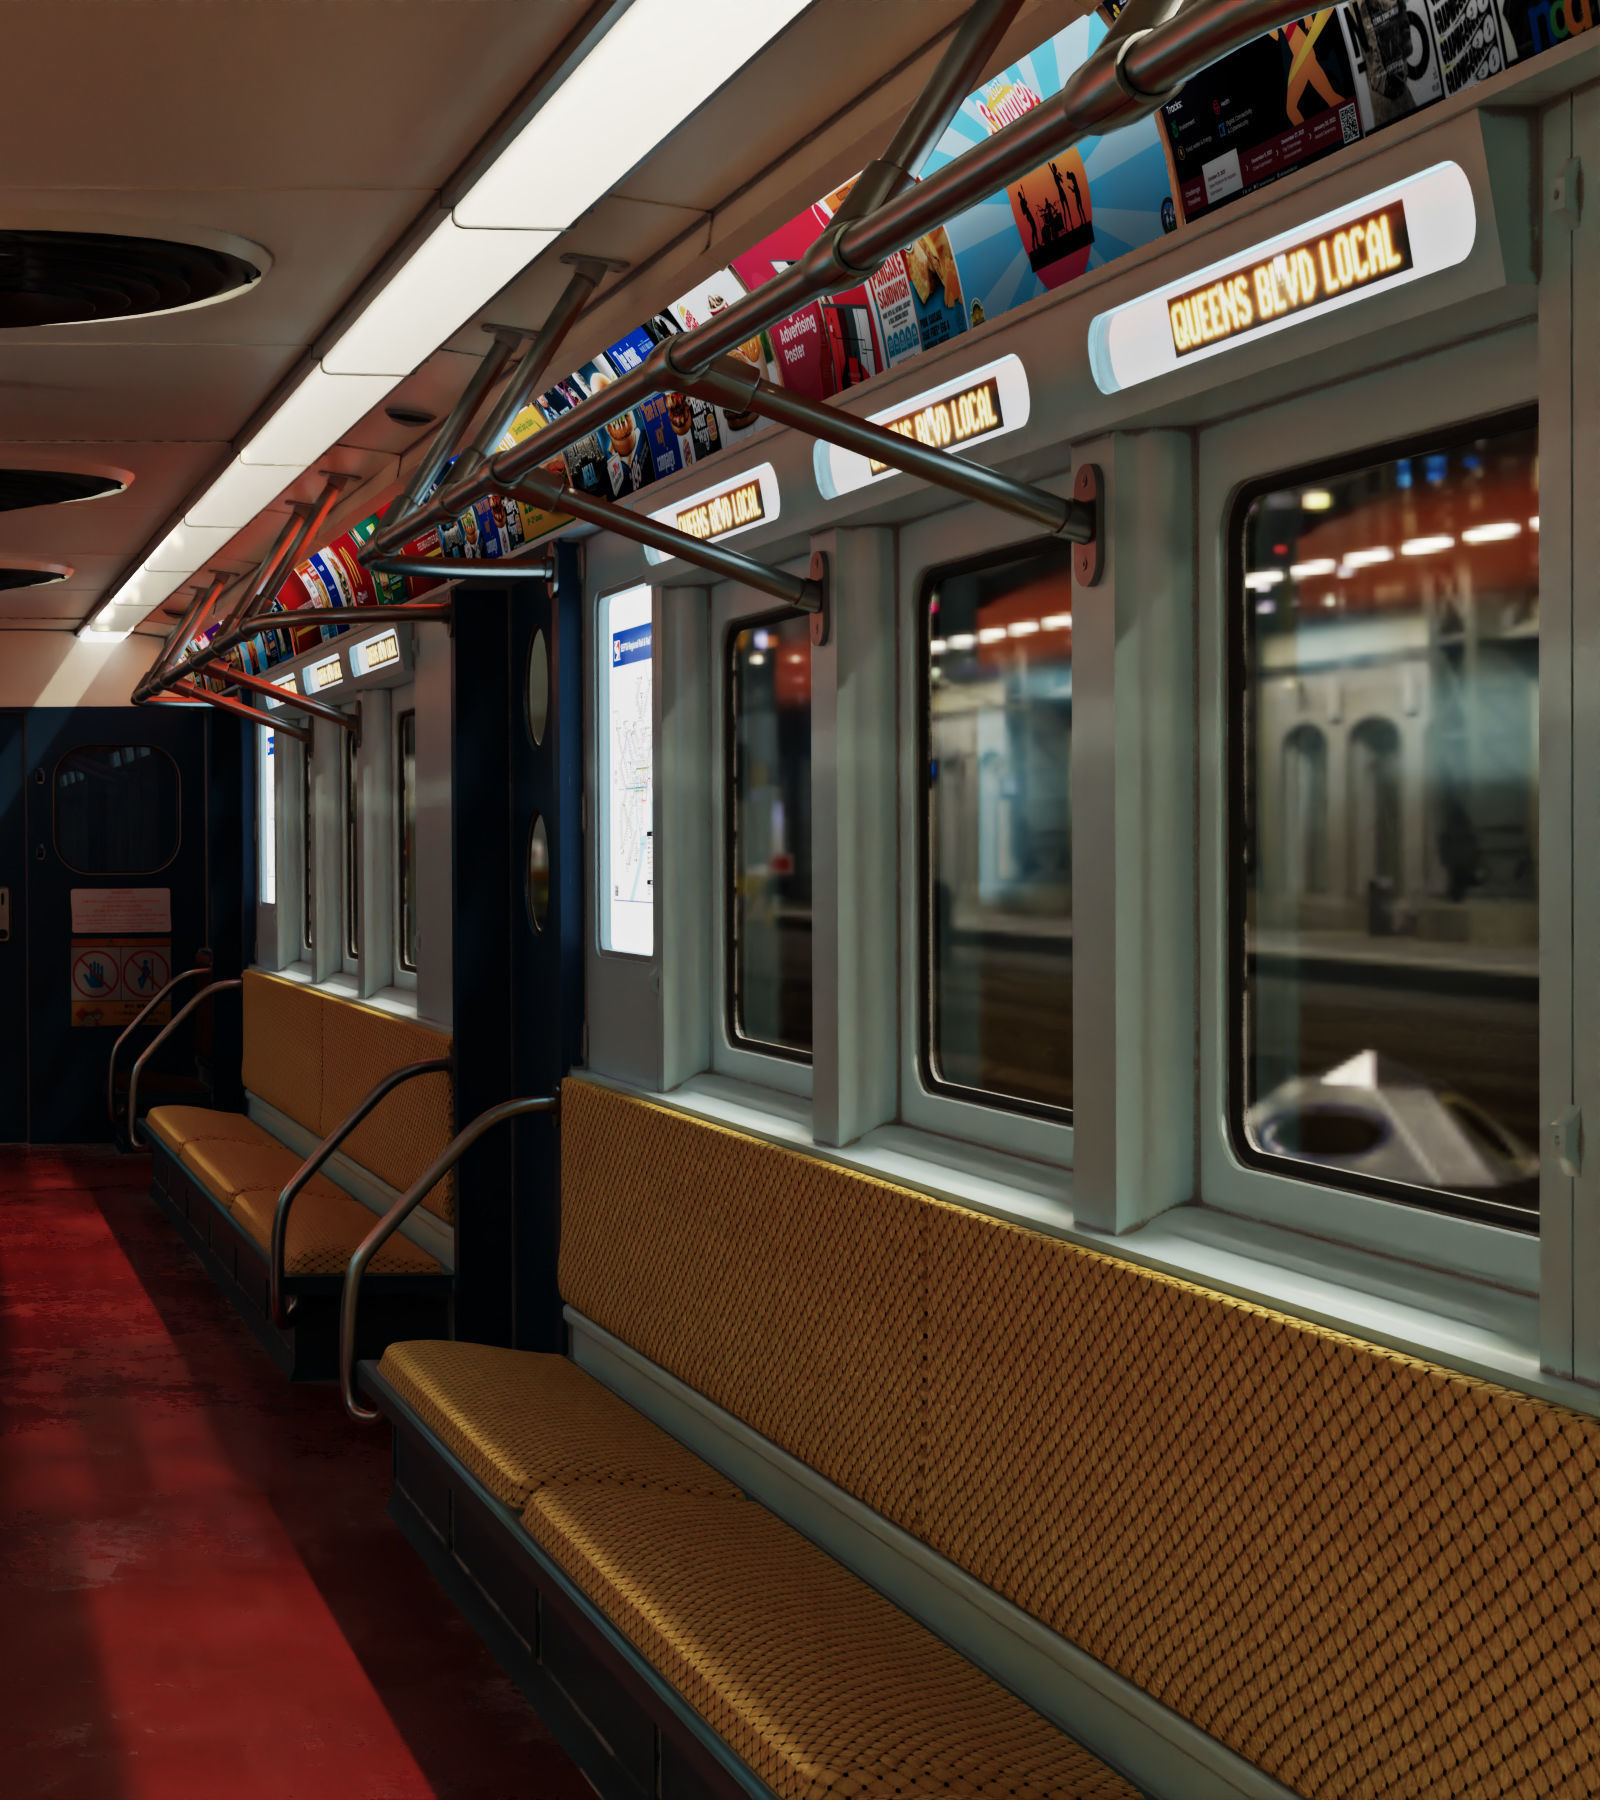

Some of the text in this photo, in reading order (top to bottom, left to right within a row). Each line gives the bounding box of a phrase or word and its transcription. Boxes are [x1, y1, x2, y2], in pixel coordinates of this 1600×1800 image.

[877, 277, 910, 310] SANDWICH
[1170, 213, 1402, 351] QUEENS BLVD LOCAL
[779, 311, 817, 345] Advertising
[784, 344, 806, 366] Poster
[914, 403, 951, 448] BLVD
[951, 385, 998, 440] LOCAL
[677, 485, 761, 539] QUEENS BLVD LOCAL
